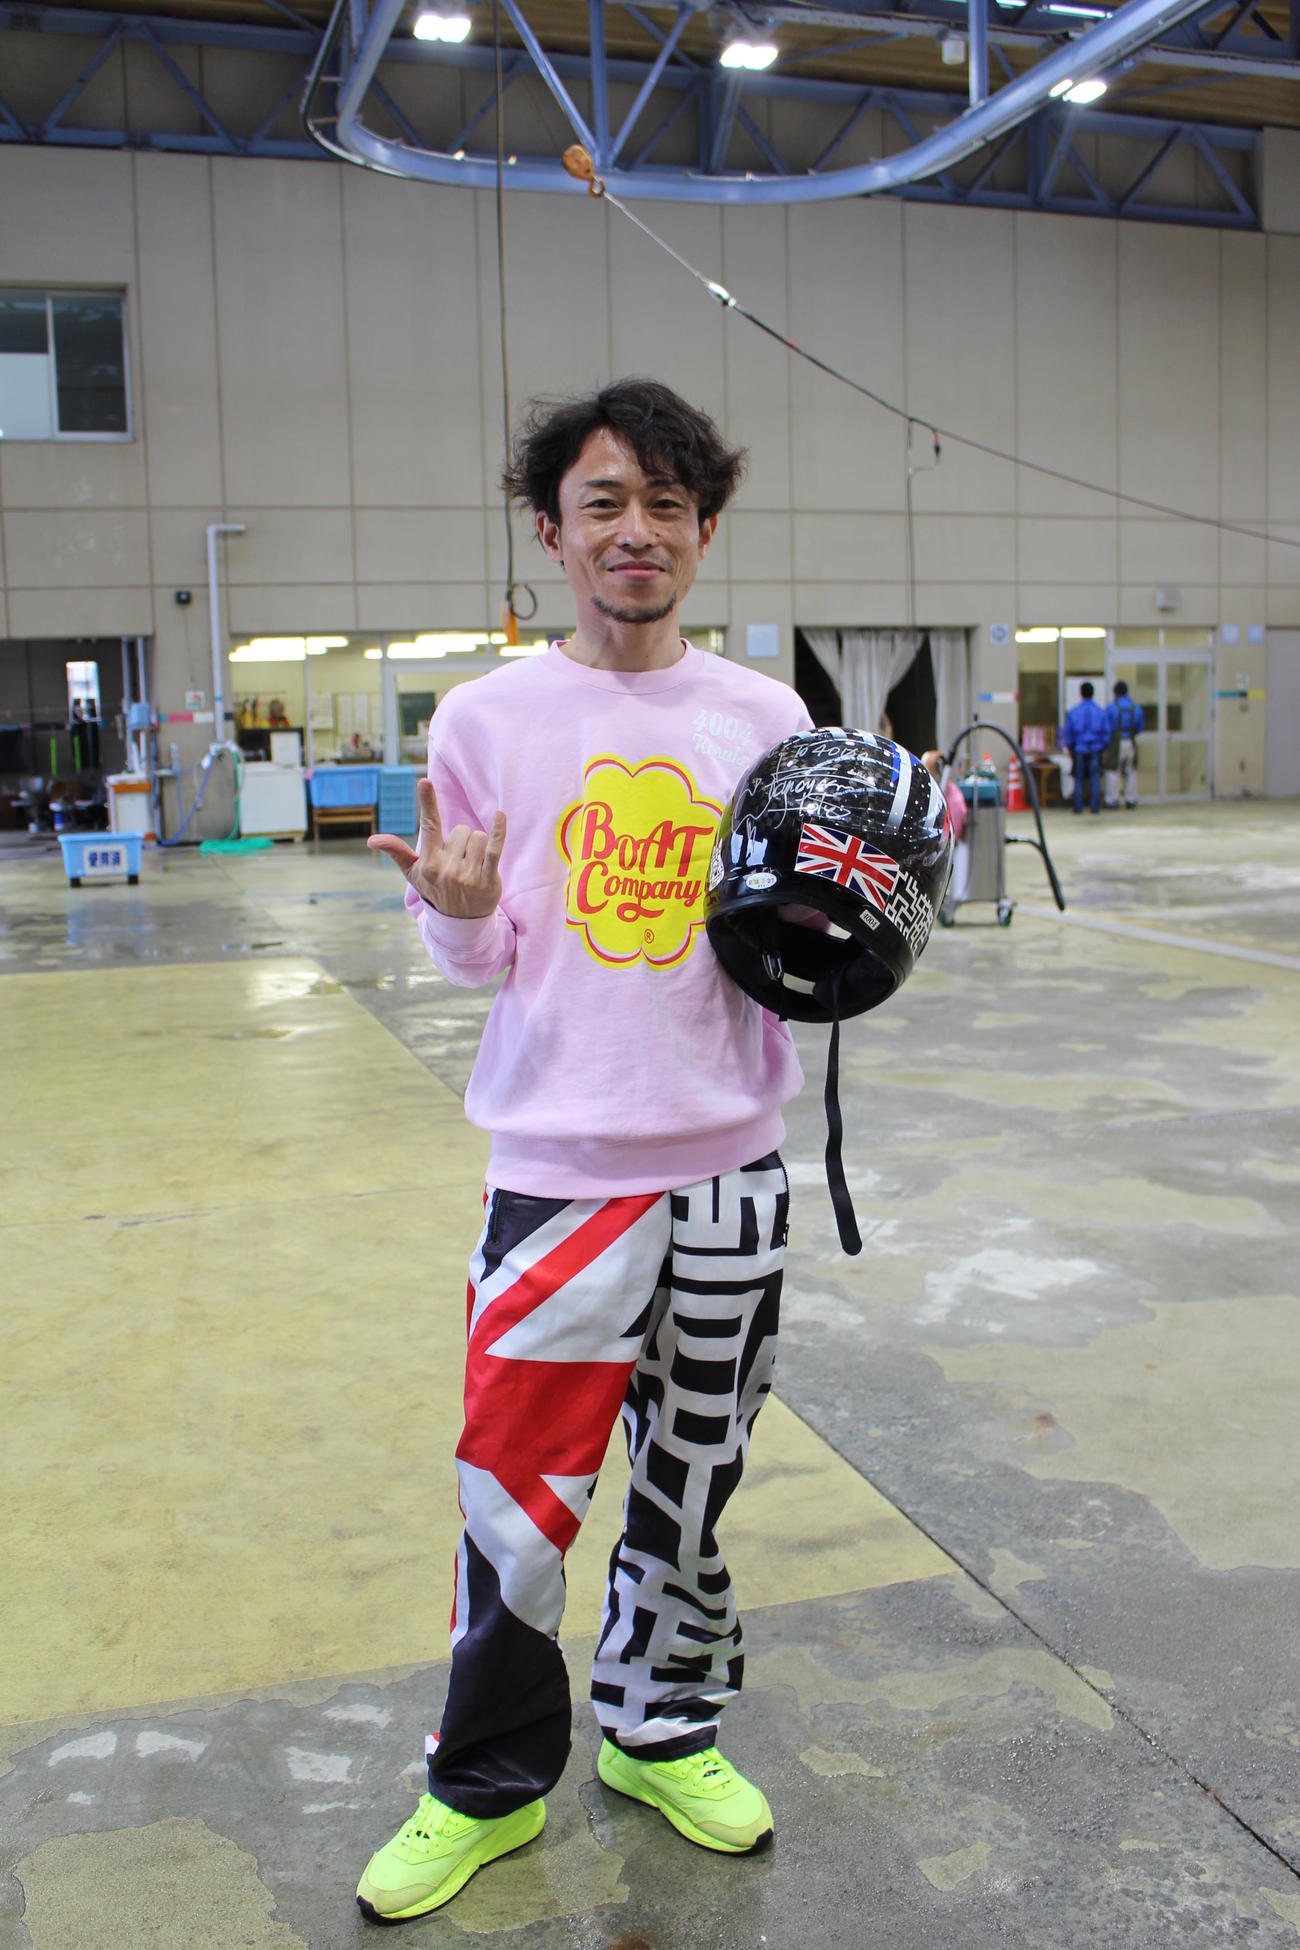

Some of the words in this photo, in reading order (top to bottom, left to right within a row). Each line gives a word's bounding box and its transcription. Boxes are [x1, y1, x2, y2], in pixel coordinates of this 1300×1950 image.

[691, 709, 753, 746] 4004
[89, 851, 121, 867] 使用済
[577, 860, 702, 923] Company
